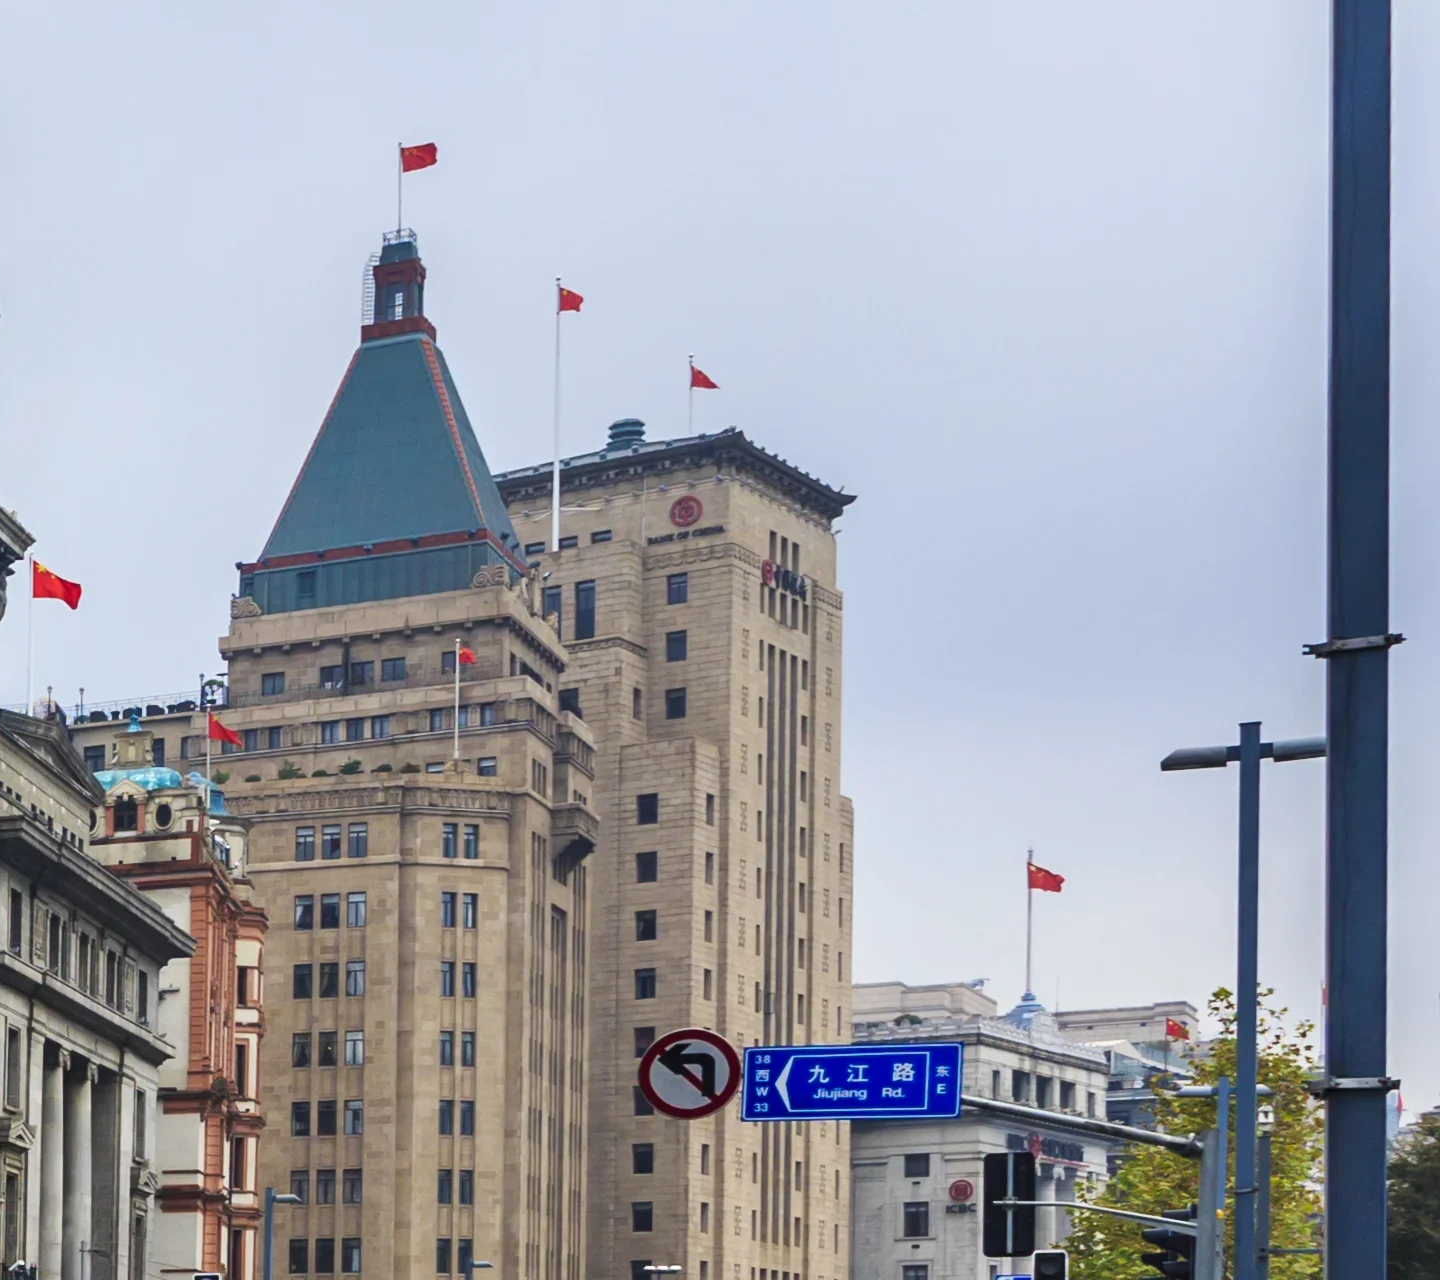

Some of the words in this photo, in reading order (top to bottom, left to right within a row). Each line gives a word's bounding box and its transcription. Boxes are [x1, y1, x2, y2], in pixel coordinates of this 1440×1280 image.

[754, 1055, 771, 1064] 38
[755, 1069, 770, 1082] 西
[807, 1063, 915, 1083] 九江路
[935, 1066, 950, 1078] 东
[756, 1087, 769, 1097] W
[813, 1088, 868, 1101] Jiujiang
[882, 1087, 906, 1098] Rd.
[936, 1083, 946, 1094] E
[754, 1103, 769, 1112] 33
